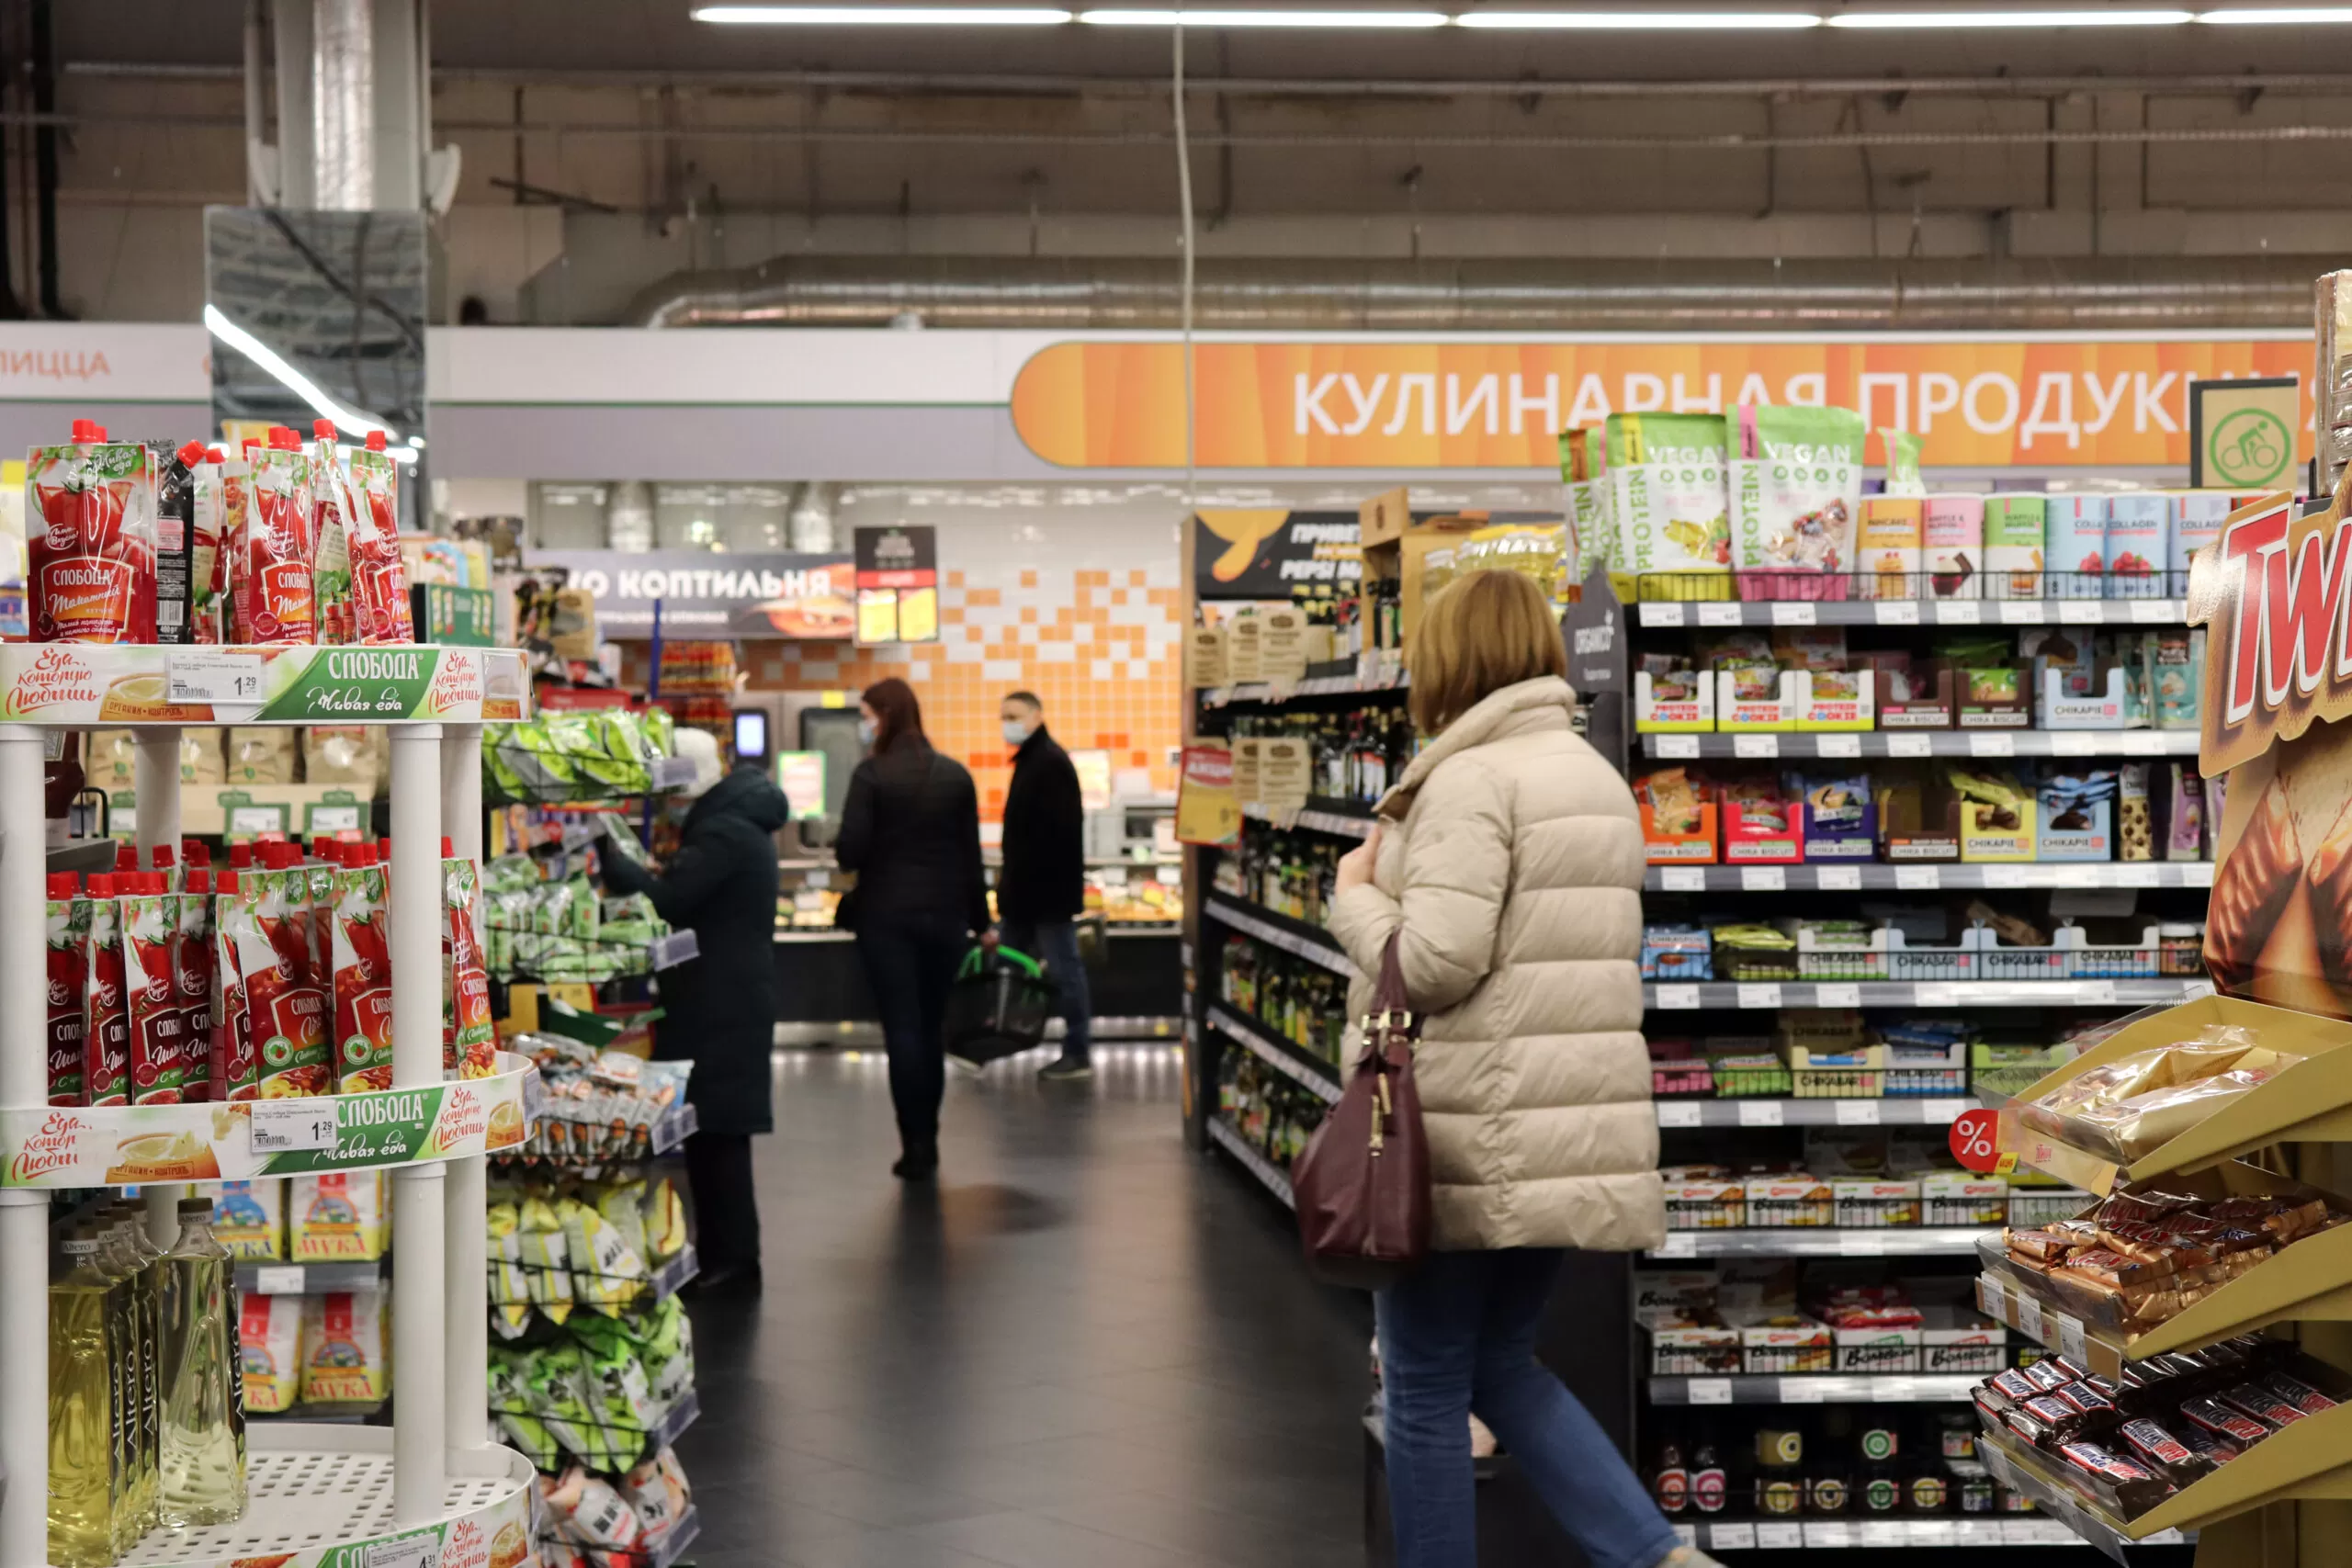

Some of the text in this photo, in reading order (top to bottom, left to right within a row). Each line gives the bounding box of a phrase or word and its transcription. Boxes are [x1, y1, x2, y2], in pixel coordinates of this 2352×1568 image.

[1859, 372, 2315, 448] ПРОДУК
[1763, 441, 1851, 463] VEGAN
[1628, 468, 1654, 570] PROTEIN
[1742, 463, 1761, 566] PROTEIN
[53, 569, 112, 587] СЛОБОДА
[617, 568, 831, 602] КОПТИЛЬНЯ
[328, 651, 419, 680] СЛОБОДА
[6, 682, 101, 716] Любишь
[306, 685, 402, 714] Живая еда
[336, 1093, 424, 1128] СЛОБОДА
[380, 1129, 407, 1155] еда
[181, 1212, 207, 1223] Altero
[62, 1243, 91, 1252] Altero
[227, 1240, 273, 1257] УКА
[297, 1237, 368, 1257] МУКА
[232, 1325, 245, 1419] Altero
[126, 1350, 137, 1450] Altero
[143, 1339, 153, 1437] Altero
[250, 1390, 279, 1407] КА
[304, 1380, 375, 1399] МУКА
